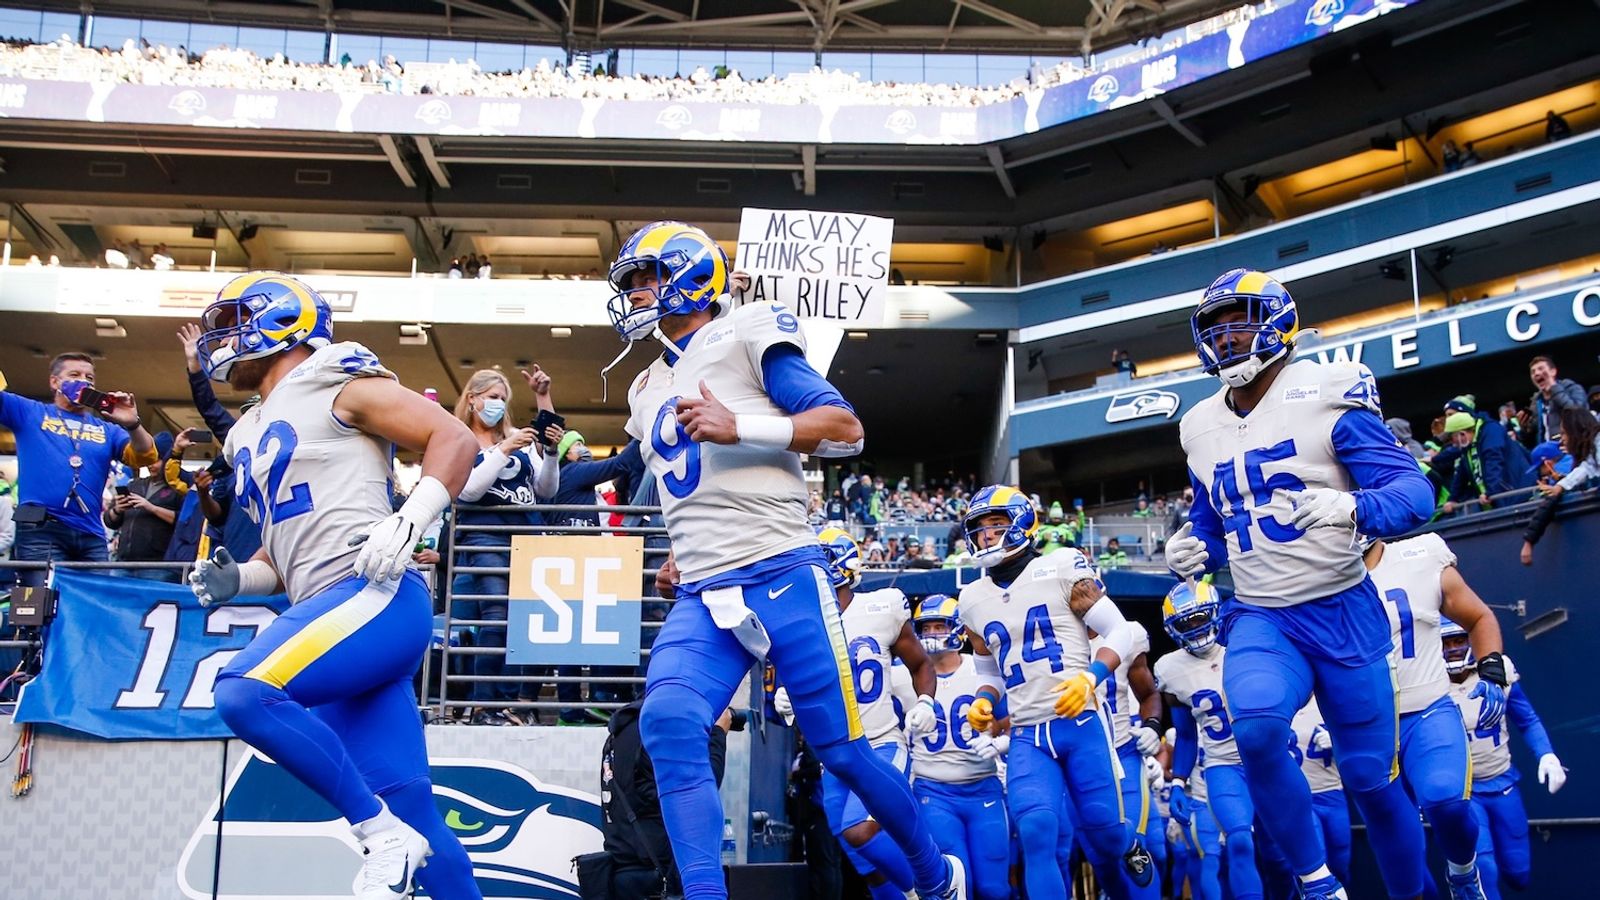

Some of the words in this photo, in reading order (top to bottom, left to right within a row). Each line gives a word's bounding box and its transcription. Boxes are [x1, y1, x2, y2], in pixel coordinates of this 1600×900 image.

[739, 242, 824, 274] THINKS
[836, 242, 887, 280] HE'S
[739, 274, 784, 306] PAT
[796, 276, 873, 320] RILEY
[776, 313, 799, 334] 9
[651, 395, 702, 500] 9
[1210, 438, 1308, 553] 45
[528, 556, 622, 645] SE
[112, 601, 283, 710] 12
[983, 603, 1065, 690] 24
